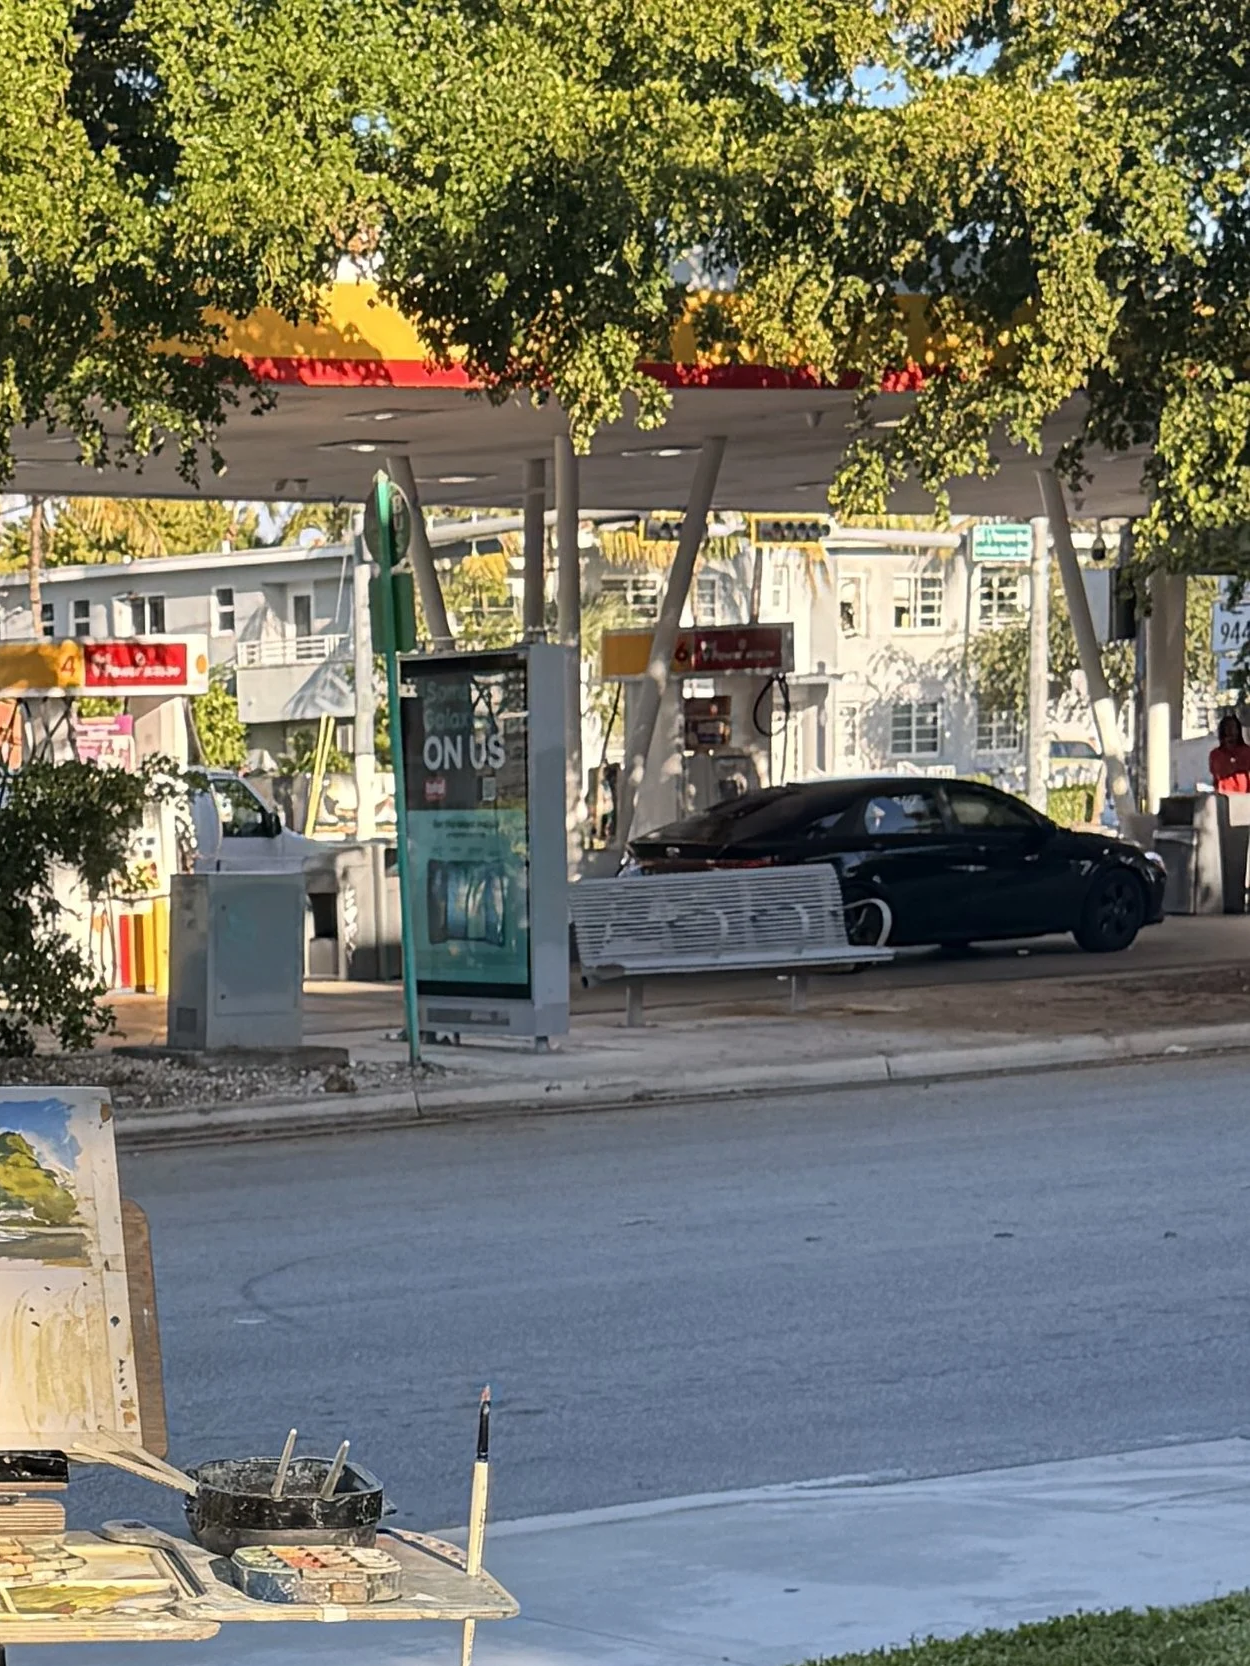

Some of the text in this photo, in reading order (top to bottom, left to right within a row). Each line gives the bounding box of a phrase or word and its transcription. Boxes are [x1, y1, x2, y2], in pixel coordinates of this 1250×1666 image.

[674, 641, 689, 663] 6
[59, 655, 76, 677] 4
[423, 734, 506, 771] ON US
